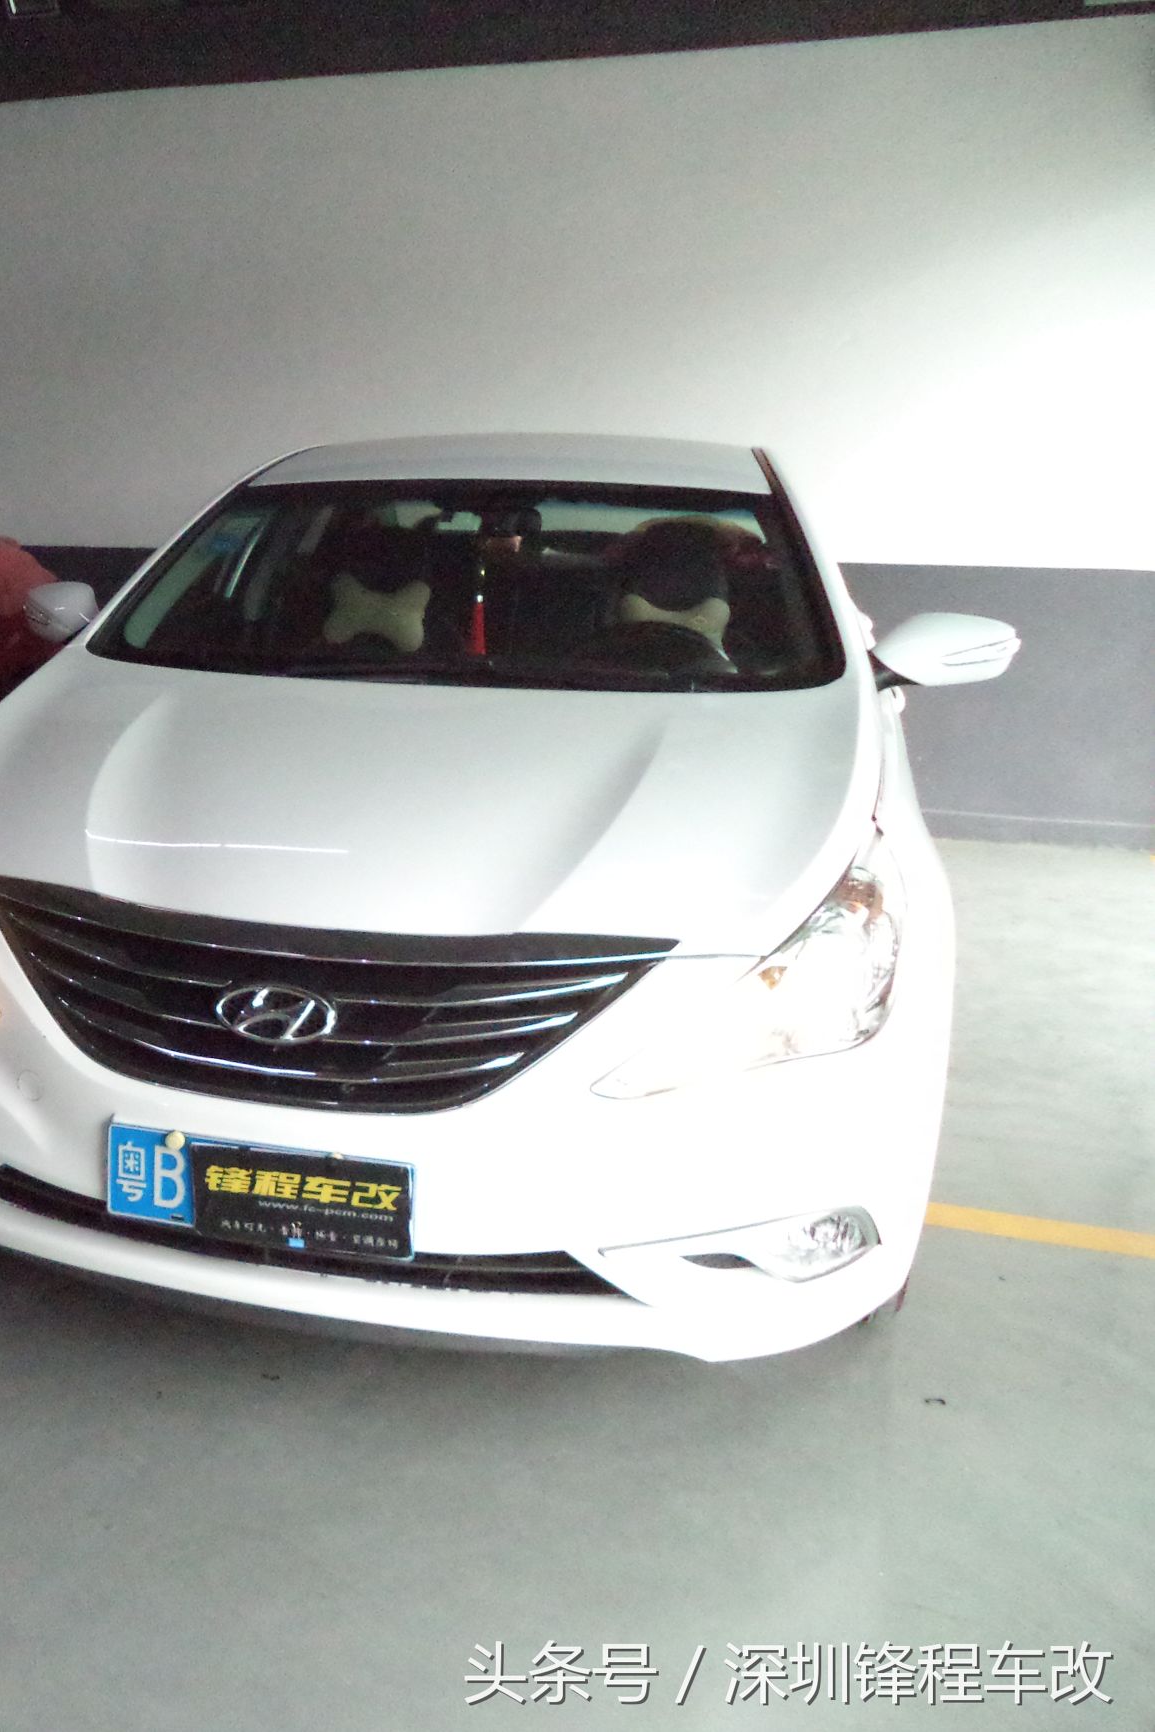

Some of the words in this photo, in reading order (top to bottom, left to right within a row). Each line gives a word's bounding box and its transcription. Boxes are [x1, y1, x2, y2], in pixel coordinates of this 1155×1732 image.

[116, 1140, 186, 1209] 粤B
[205, 1164, 402, 1211] 锋程车改
